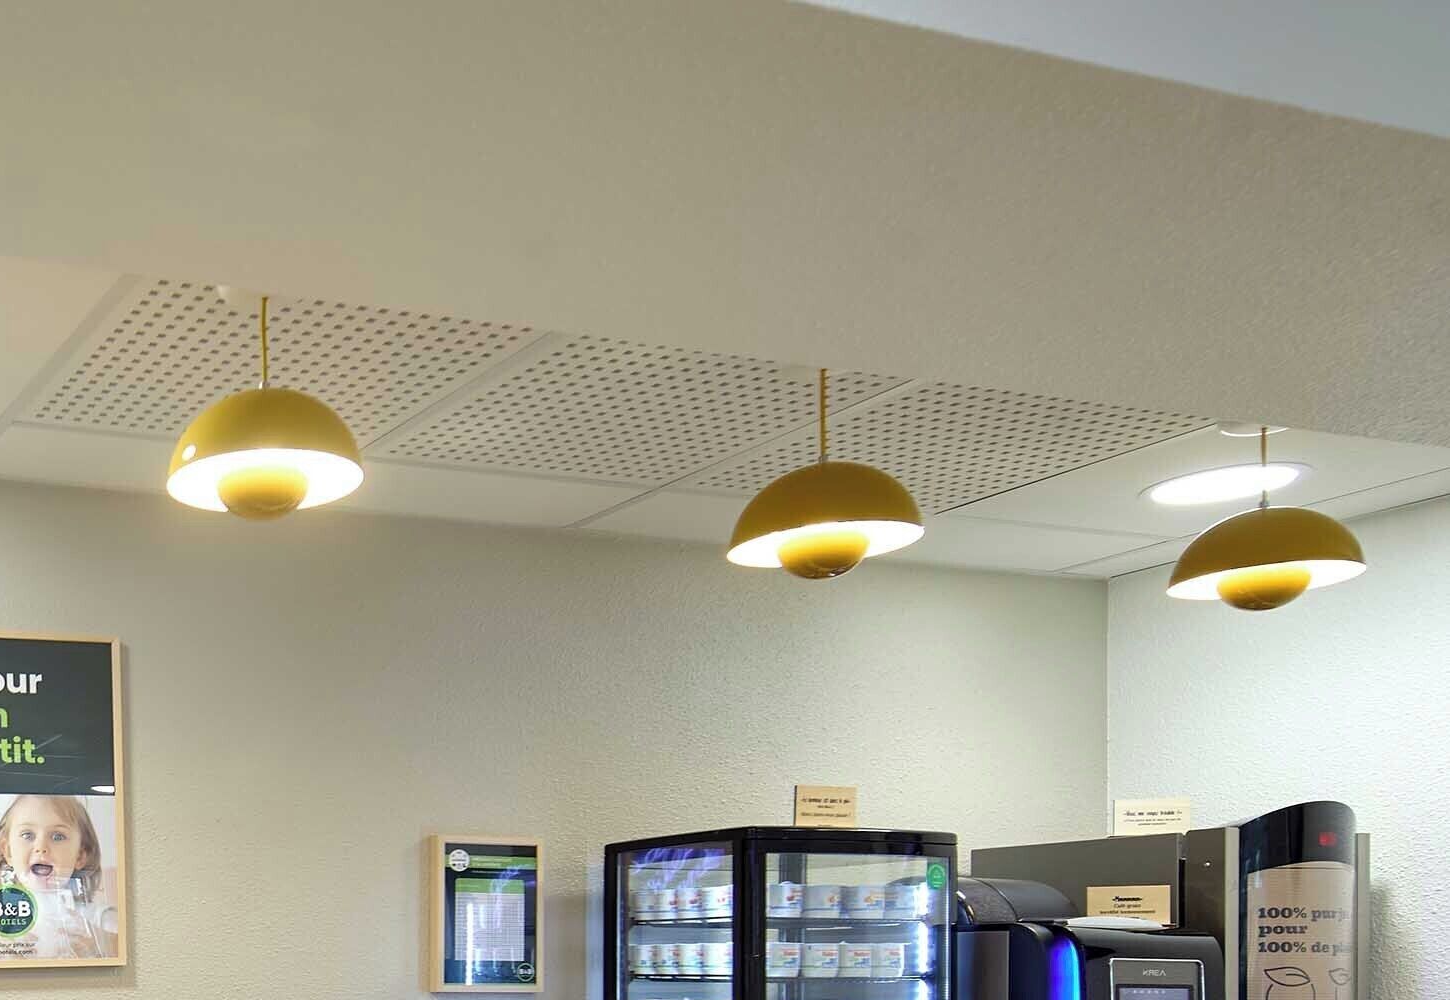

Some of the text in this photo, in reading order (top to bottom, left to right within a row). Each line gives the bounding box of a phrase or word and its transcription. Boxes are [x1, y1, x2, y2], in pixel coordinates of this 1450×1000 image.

[1257, 907, 1308, 919] 100%
[1258, 925, 1308, 938] pour
[1257, 941, 1308, 953] 100%
[1311, 941, 1329, 953] de
